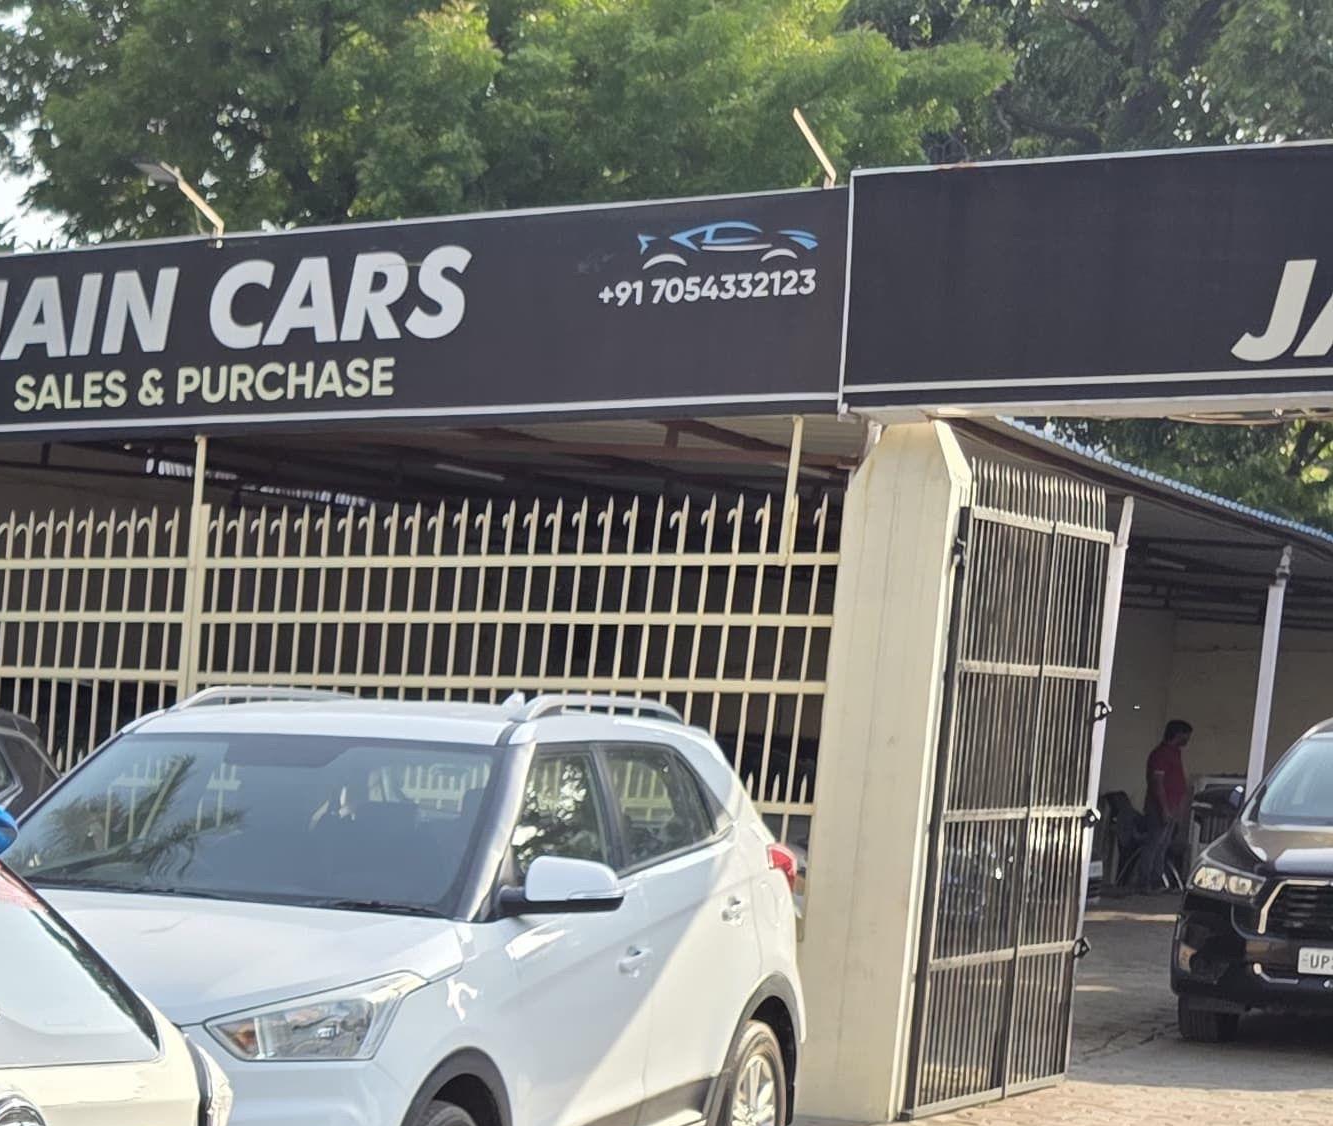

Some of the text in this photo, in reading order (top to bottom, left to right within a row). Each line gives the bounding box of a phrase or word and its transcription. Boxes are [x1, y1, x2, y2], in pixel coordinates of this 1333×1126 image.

[209, 245, 472, 349] CARS
[598, 268, 816, 306] +91 7054332123
[14, 357, 395, 412] SALES & PURCHASE
[1310, 954, 1333, 969] UP
